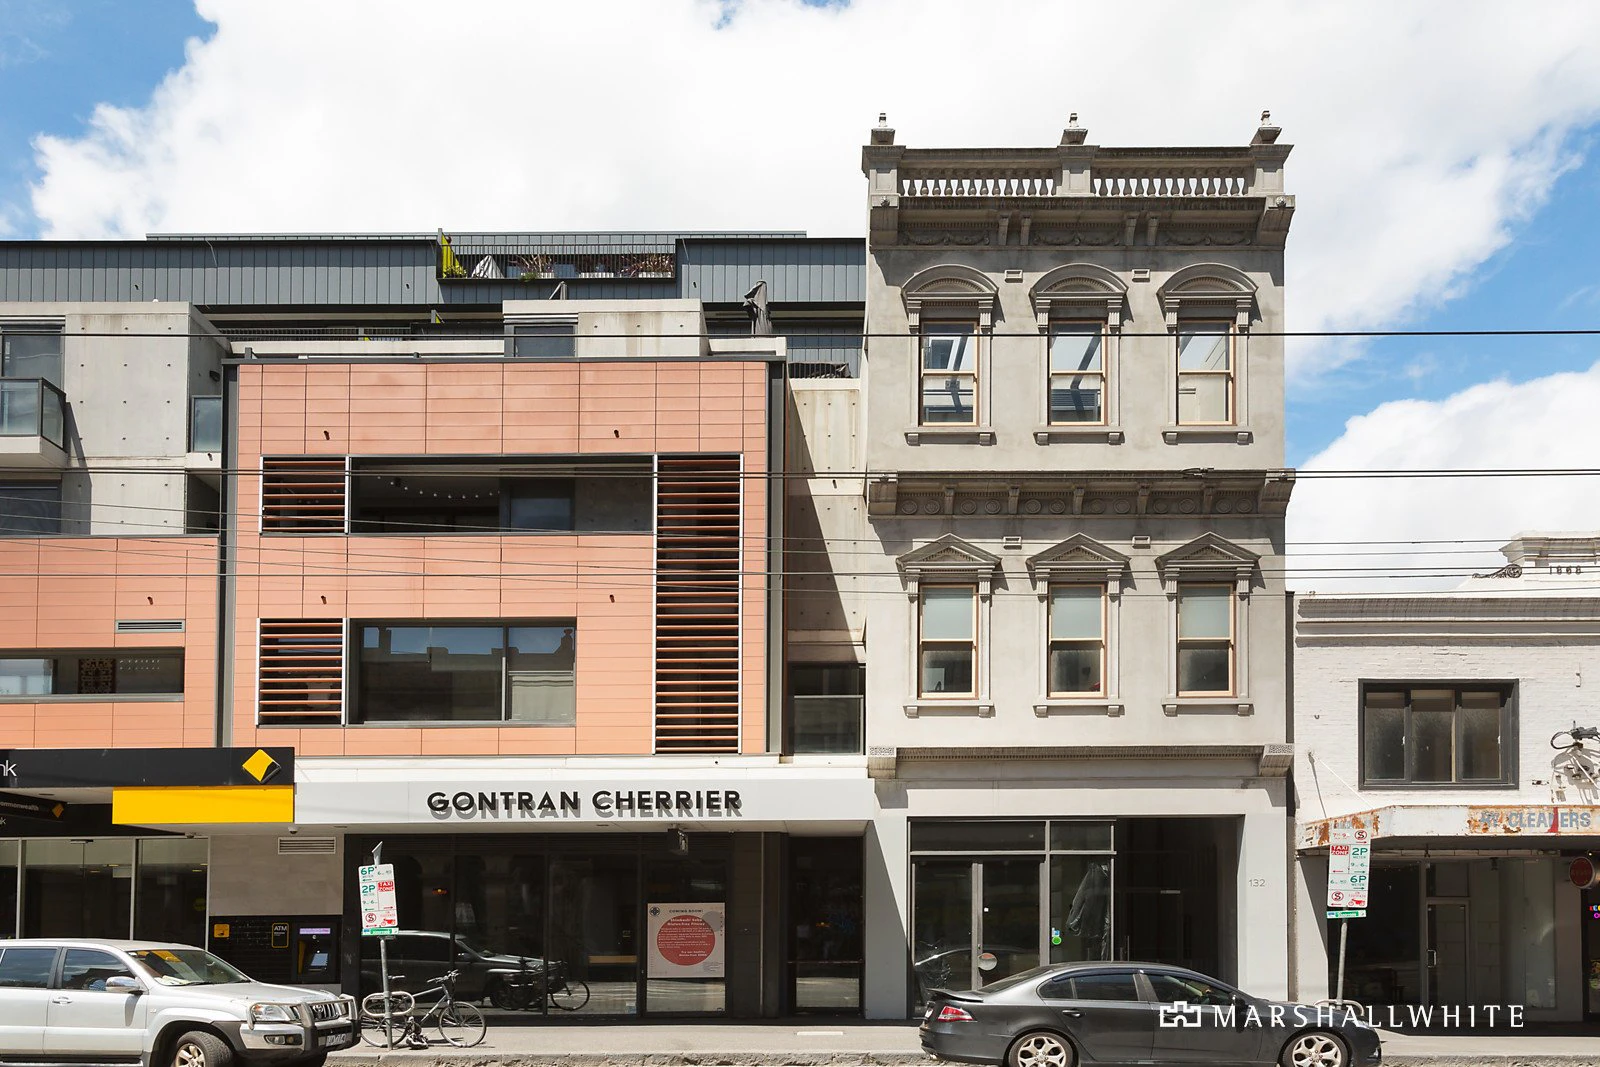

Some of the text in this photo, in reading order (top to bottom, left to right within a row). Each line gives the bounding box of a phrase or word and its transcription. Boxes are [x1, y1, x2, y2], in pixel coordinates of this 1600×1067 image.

[427, 791, 741, 811] GONTRAN CHERRIER
[1352, 848, 1368, 856] 2P
[361, 867, 374, 875] 6P
[1249, 878, 1266, 887] 132
[1350, 875, 1367, 883] 6P
[362, 885, 375, 893] 2P
